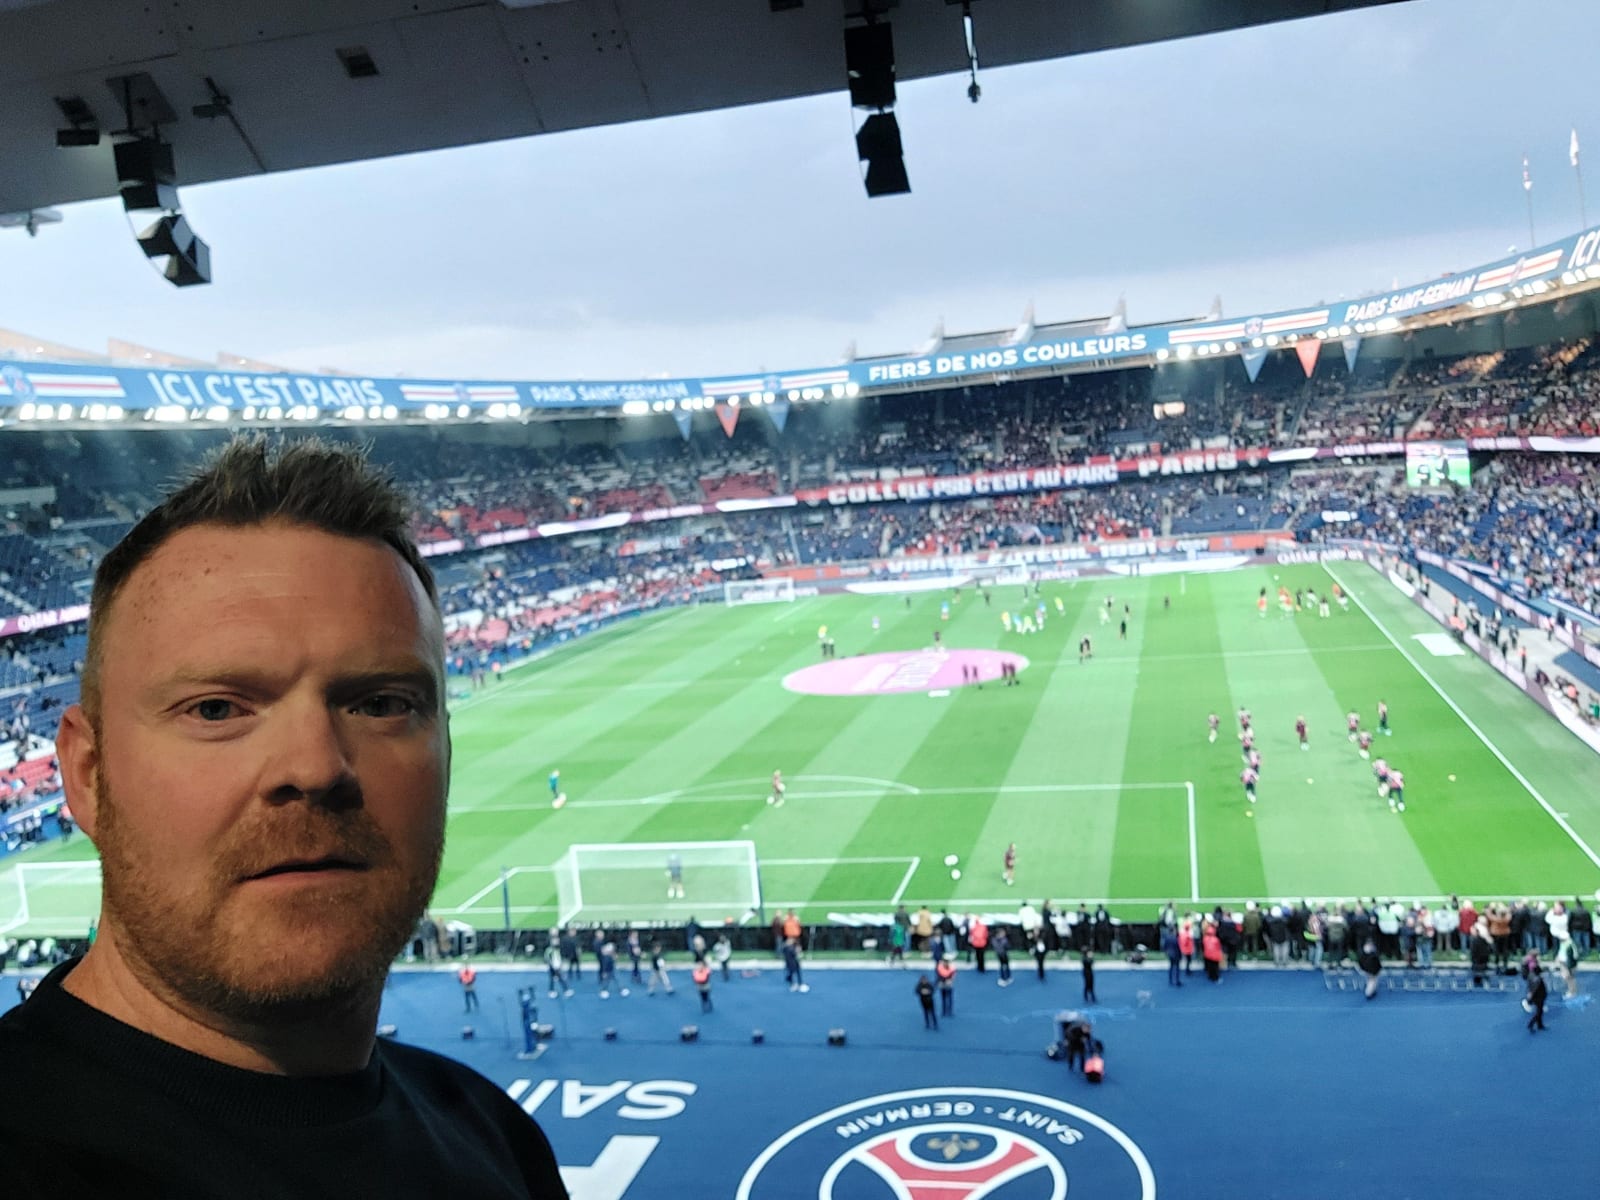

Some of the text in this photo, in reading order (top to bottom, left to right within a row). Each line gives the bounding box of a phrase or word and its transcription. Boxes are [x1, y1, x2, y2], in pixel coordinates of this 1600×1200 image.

[1344, 275, 1476, 323] PARIS SAINT-GERMAIN
[868, 334, 1147, 383] FIERS DE NOS COULEURS
[146, 372, 384, 407] ICI C'EST PARIS
[529, 385, 577, 402] PARIS
[1032, 466, 1063, 488] AU
[1063, 462, 1119, 486] PARC
[1137, 451, 1239, 478] PARIS
[506, 1079, 698, 1121] SAI
